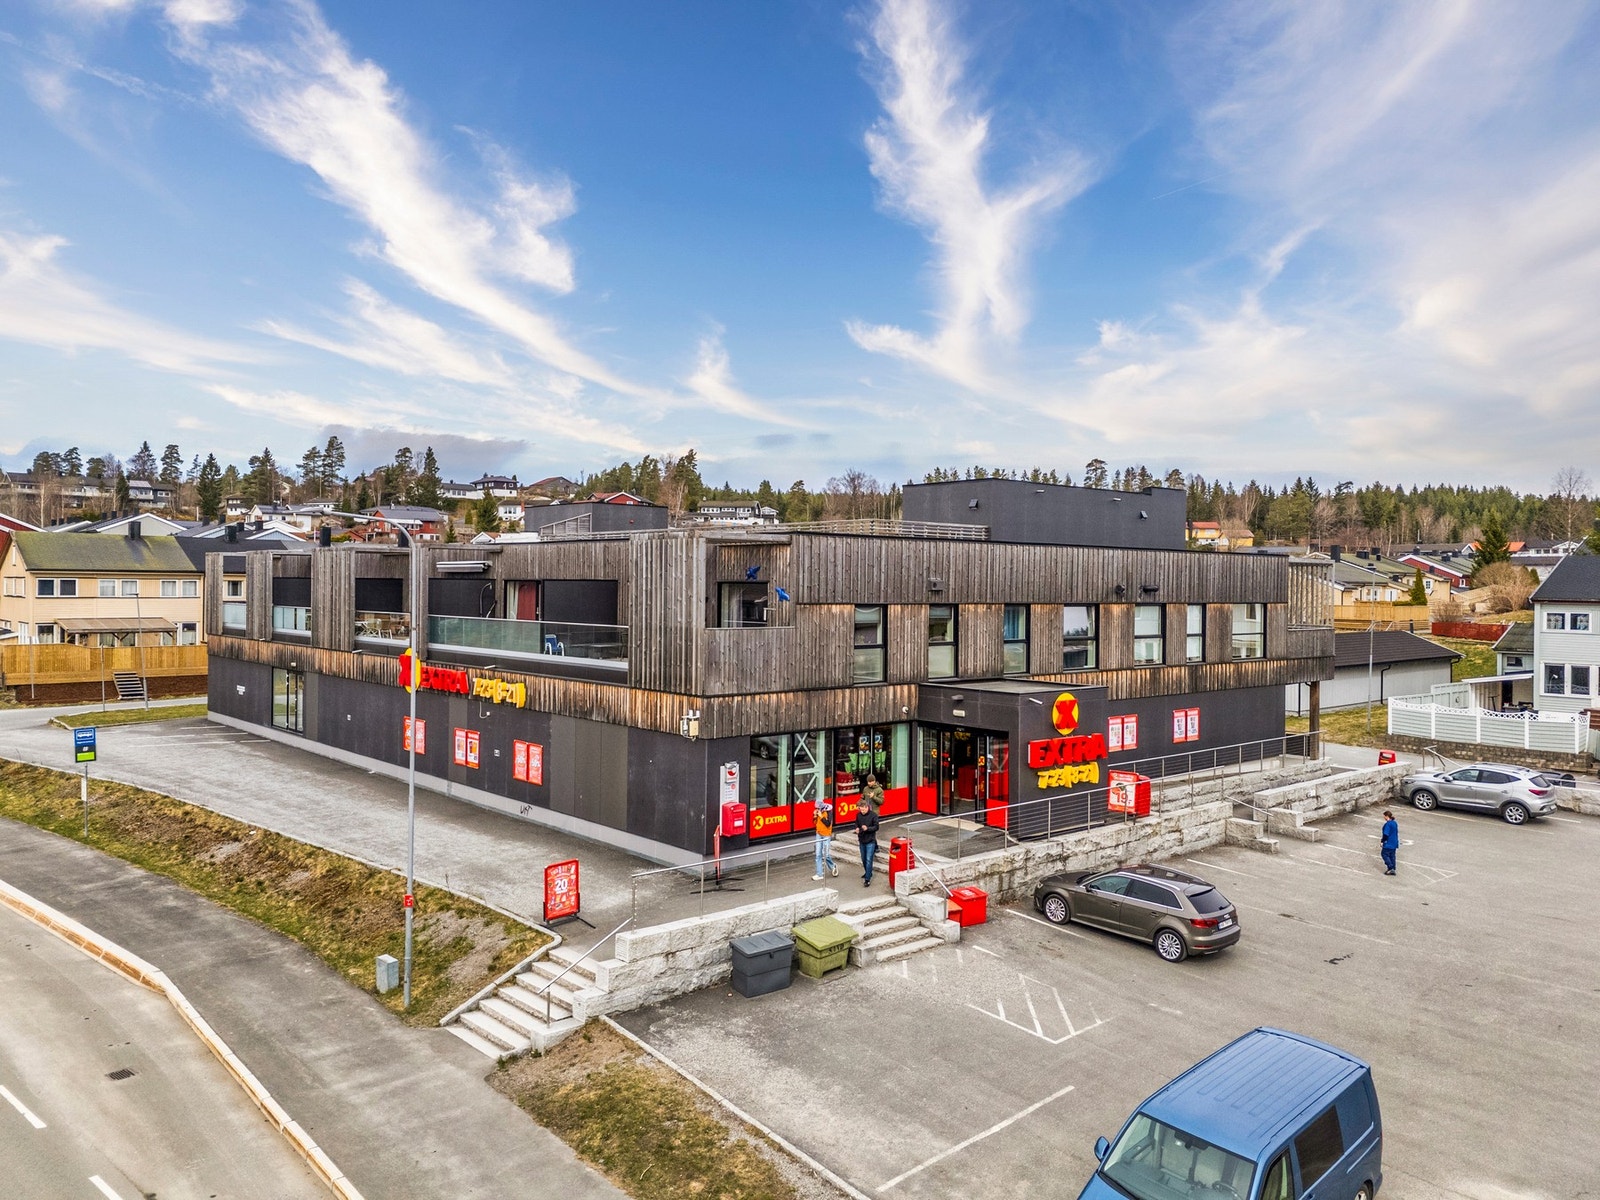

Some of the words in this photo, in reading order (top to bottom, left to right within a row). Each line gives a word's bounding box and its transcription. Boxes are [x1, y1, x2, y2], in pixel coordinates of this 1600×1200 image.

[420, 665, 469, 694] EXTRA
[1028, 733, 1108, 768] EXTRA
[765, 815, 788, 825] EXTRA
[555, 878, 568, 891] 20
